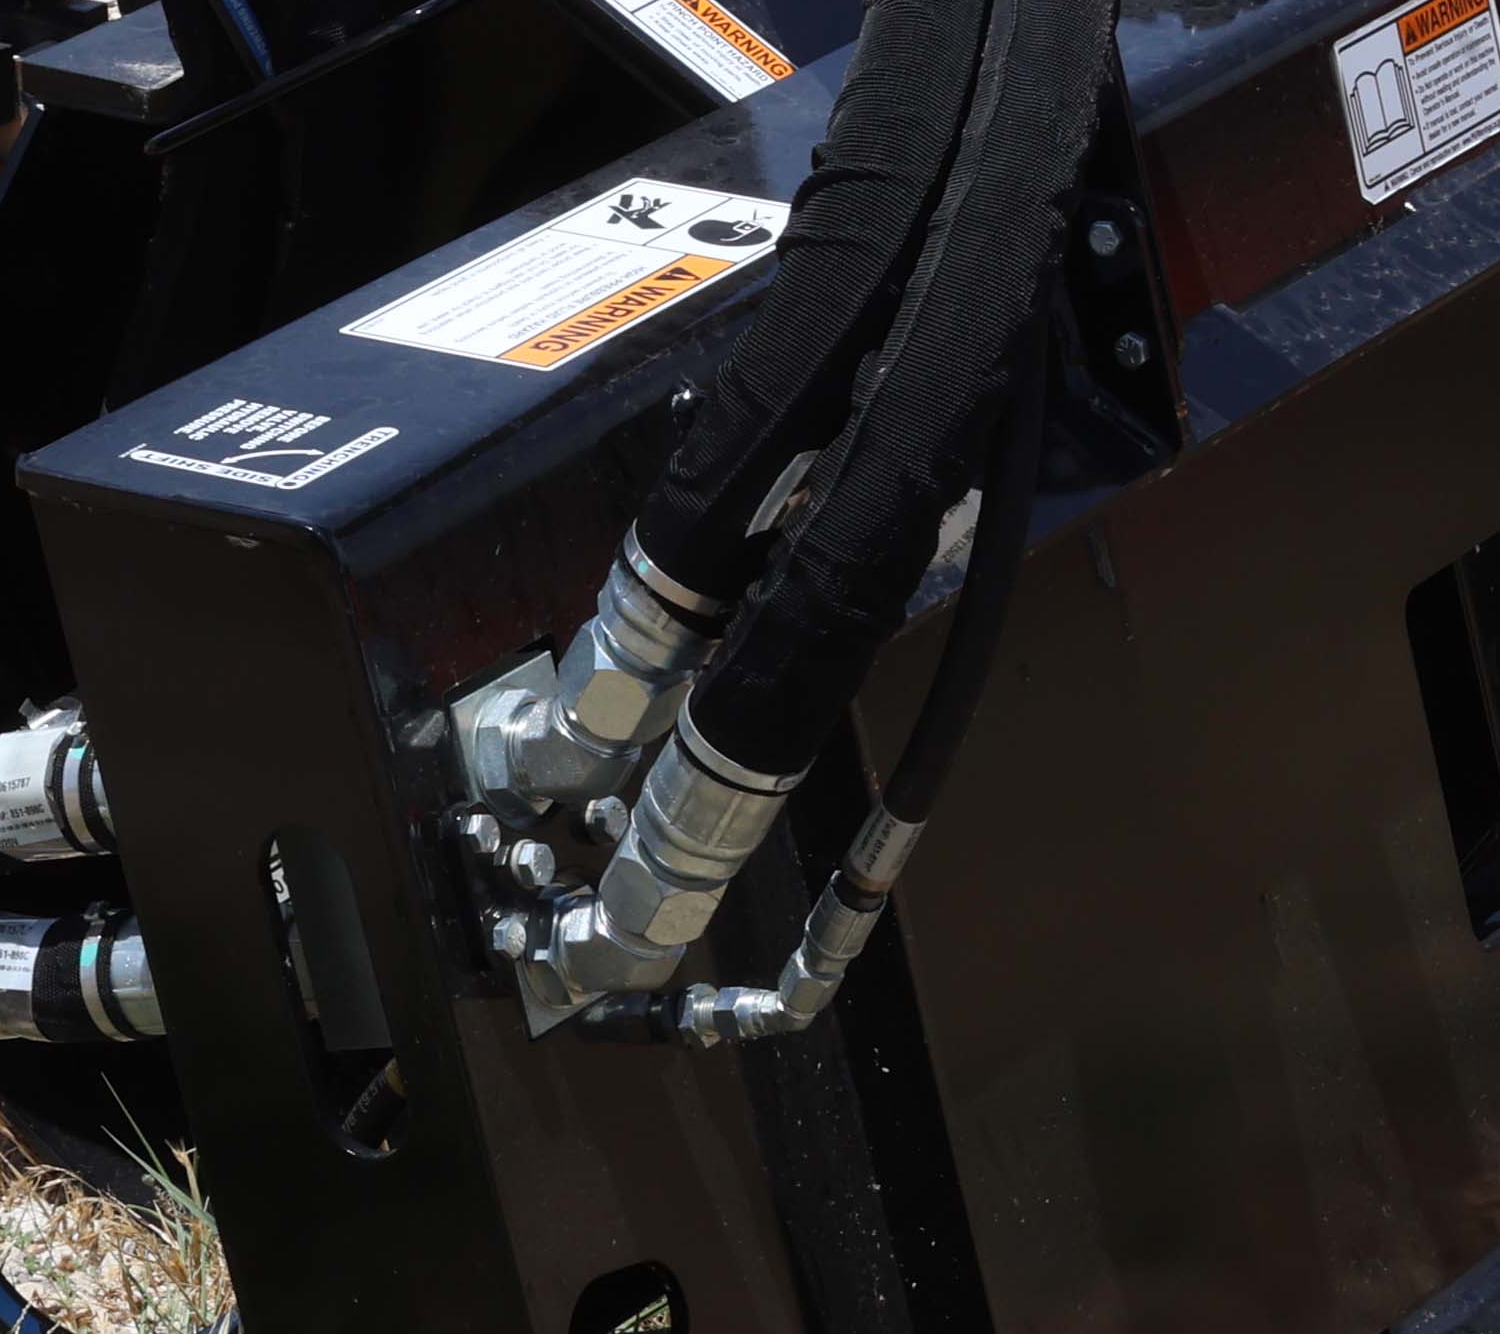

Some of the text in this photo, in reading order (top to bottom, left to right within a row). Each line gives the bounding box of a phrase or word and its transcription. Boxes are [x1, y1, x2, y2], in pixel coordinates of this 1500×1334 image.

[664, 0, 771, 82] PINCH POINT HAZARD
[696, 6, 792, 77] WARNING
[526, 283, 676, 354] WARNING
[275, 415, 332, 443] BEFORE
[293, 428, 394, 483] TRENCHING
[144, 452, 271, 484] SIDE SHIFT
